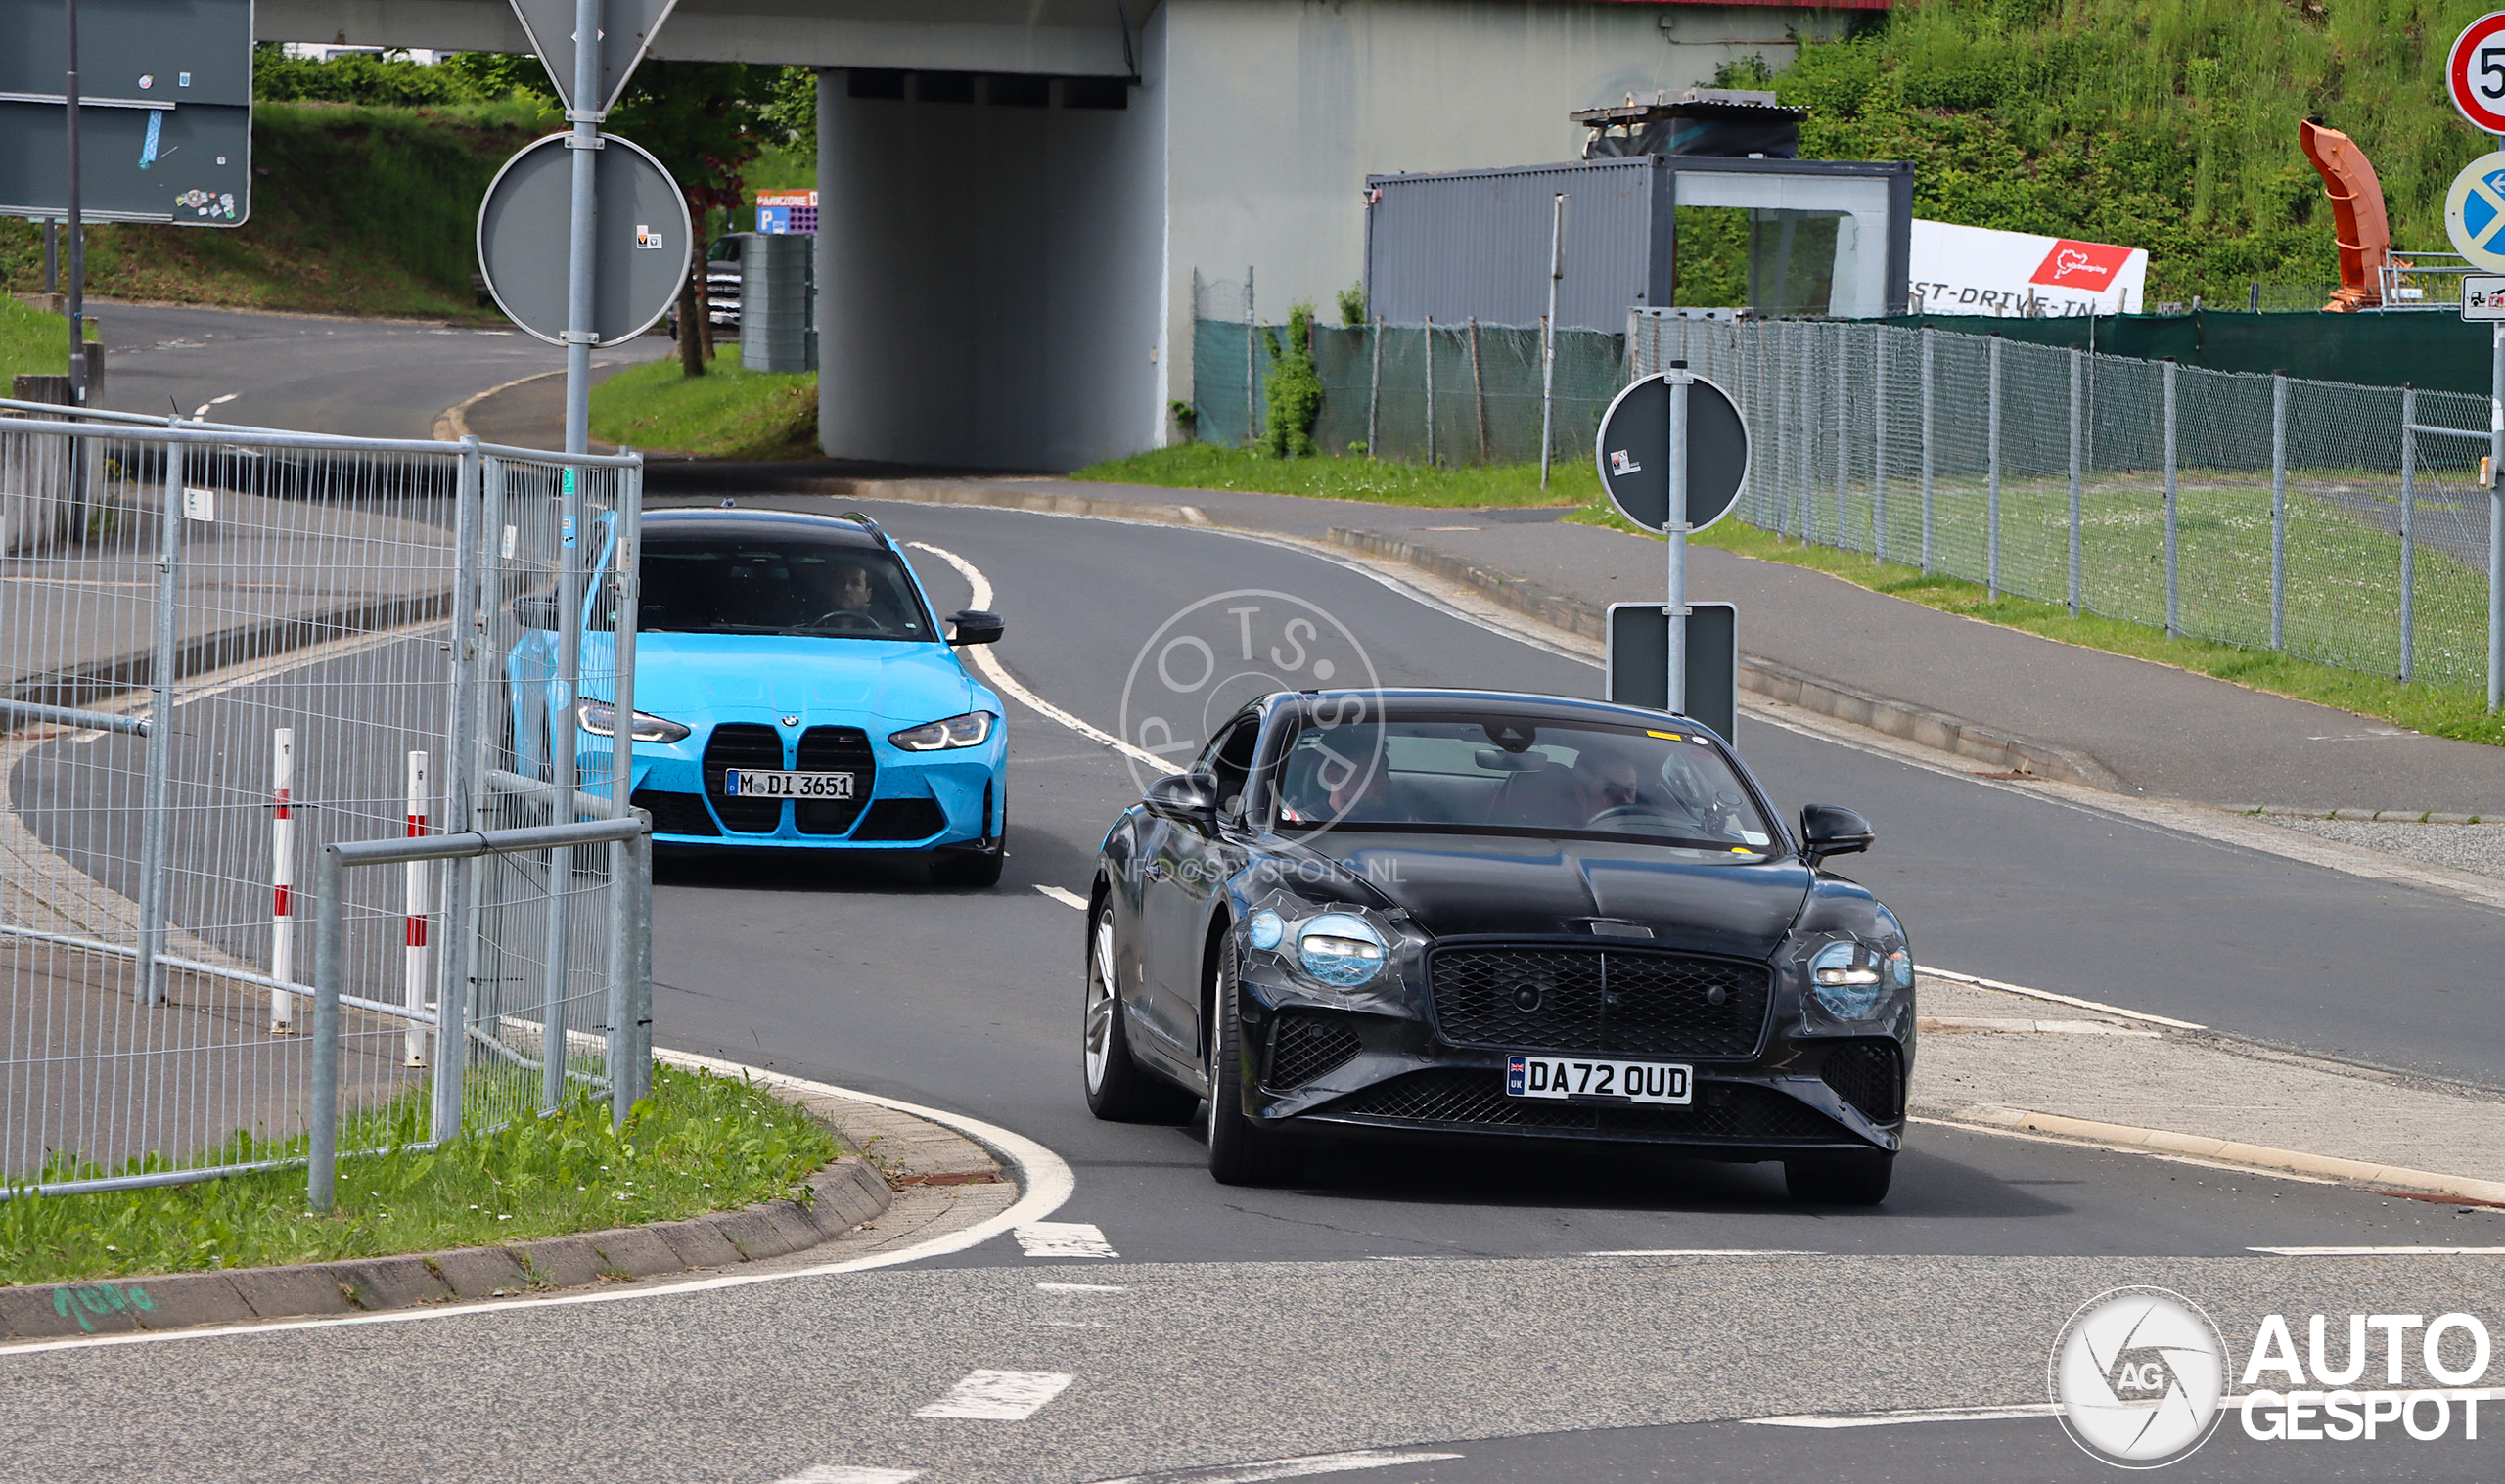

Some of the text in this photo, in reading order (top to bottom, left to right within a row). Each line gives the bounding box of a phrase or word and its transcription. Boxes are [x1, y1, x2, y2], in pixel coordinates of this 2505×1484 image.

[757, 196, 808, 206] PARKZONE
[761, 210, 773, 230] P
[768, 775, 794, 794] DI
[799, 777, 849, 796] 3651
[1511, 1080, 1523, 1089] UK
[1528, 1061, 1687, 1098] DA72 OUD
